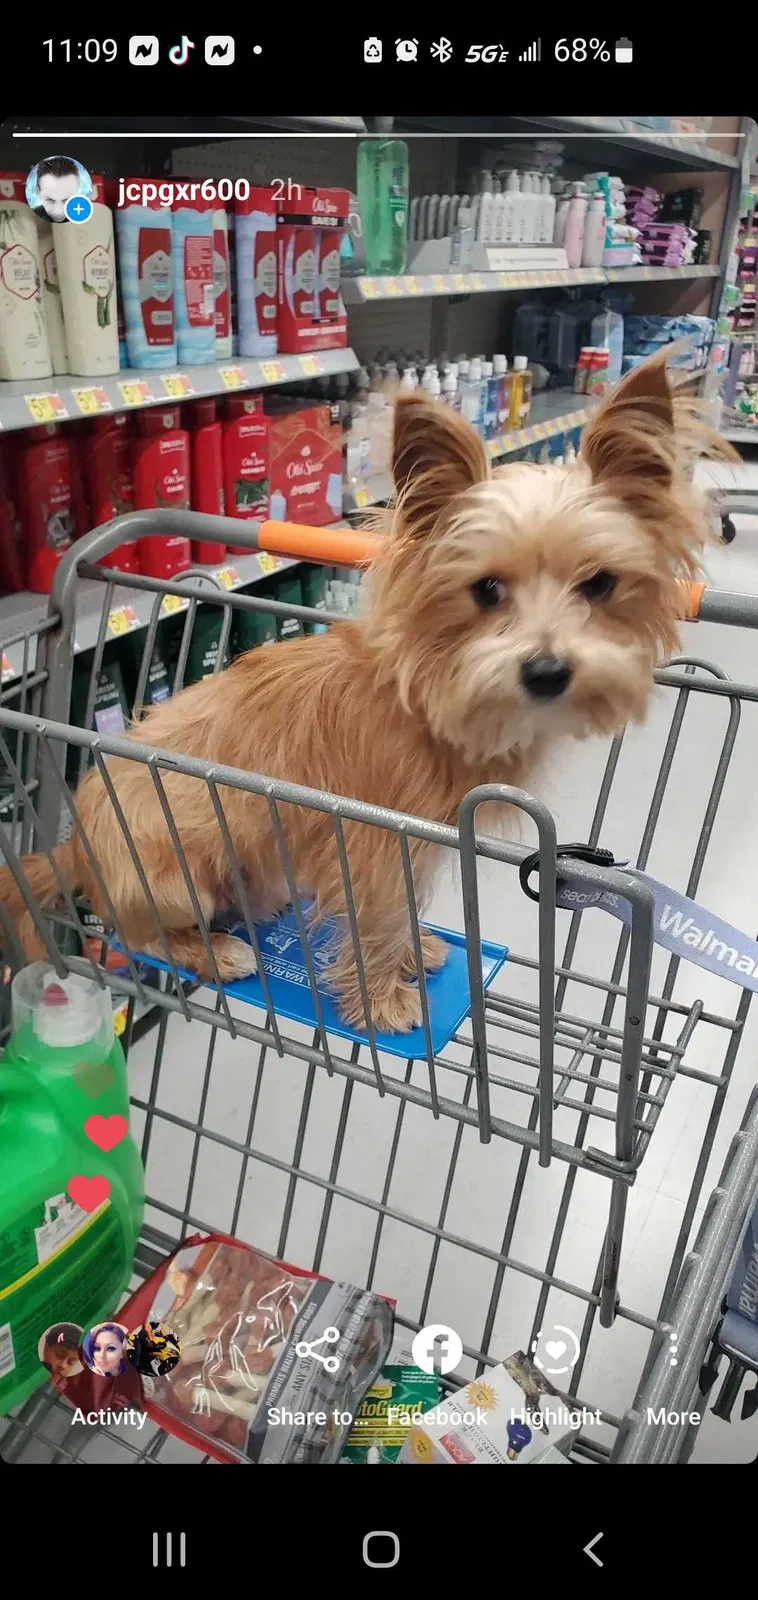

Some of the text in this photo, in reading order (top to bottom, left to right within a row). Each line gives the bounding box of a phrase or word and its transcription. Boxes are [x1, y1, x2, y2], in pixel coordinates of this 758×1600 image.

[262, 962, 305, 984] WARNI
[292, 1371, 307, 1392] ANY
[300, 1351, 316, 1371] SIZ
[266, 1372, 286, 1407] PROMOTES
[358, 1400, 422, 1417] toGuard
